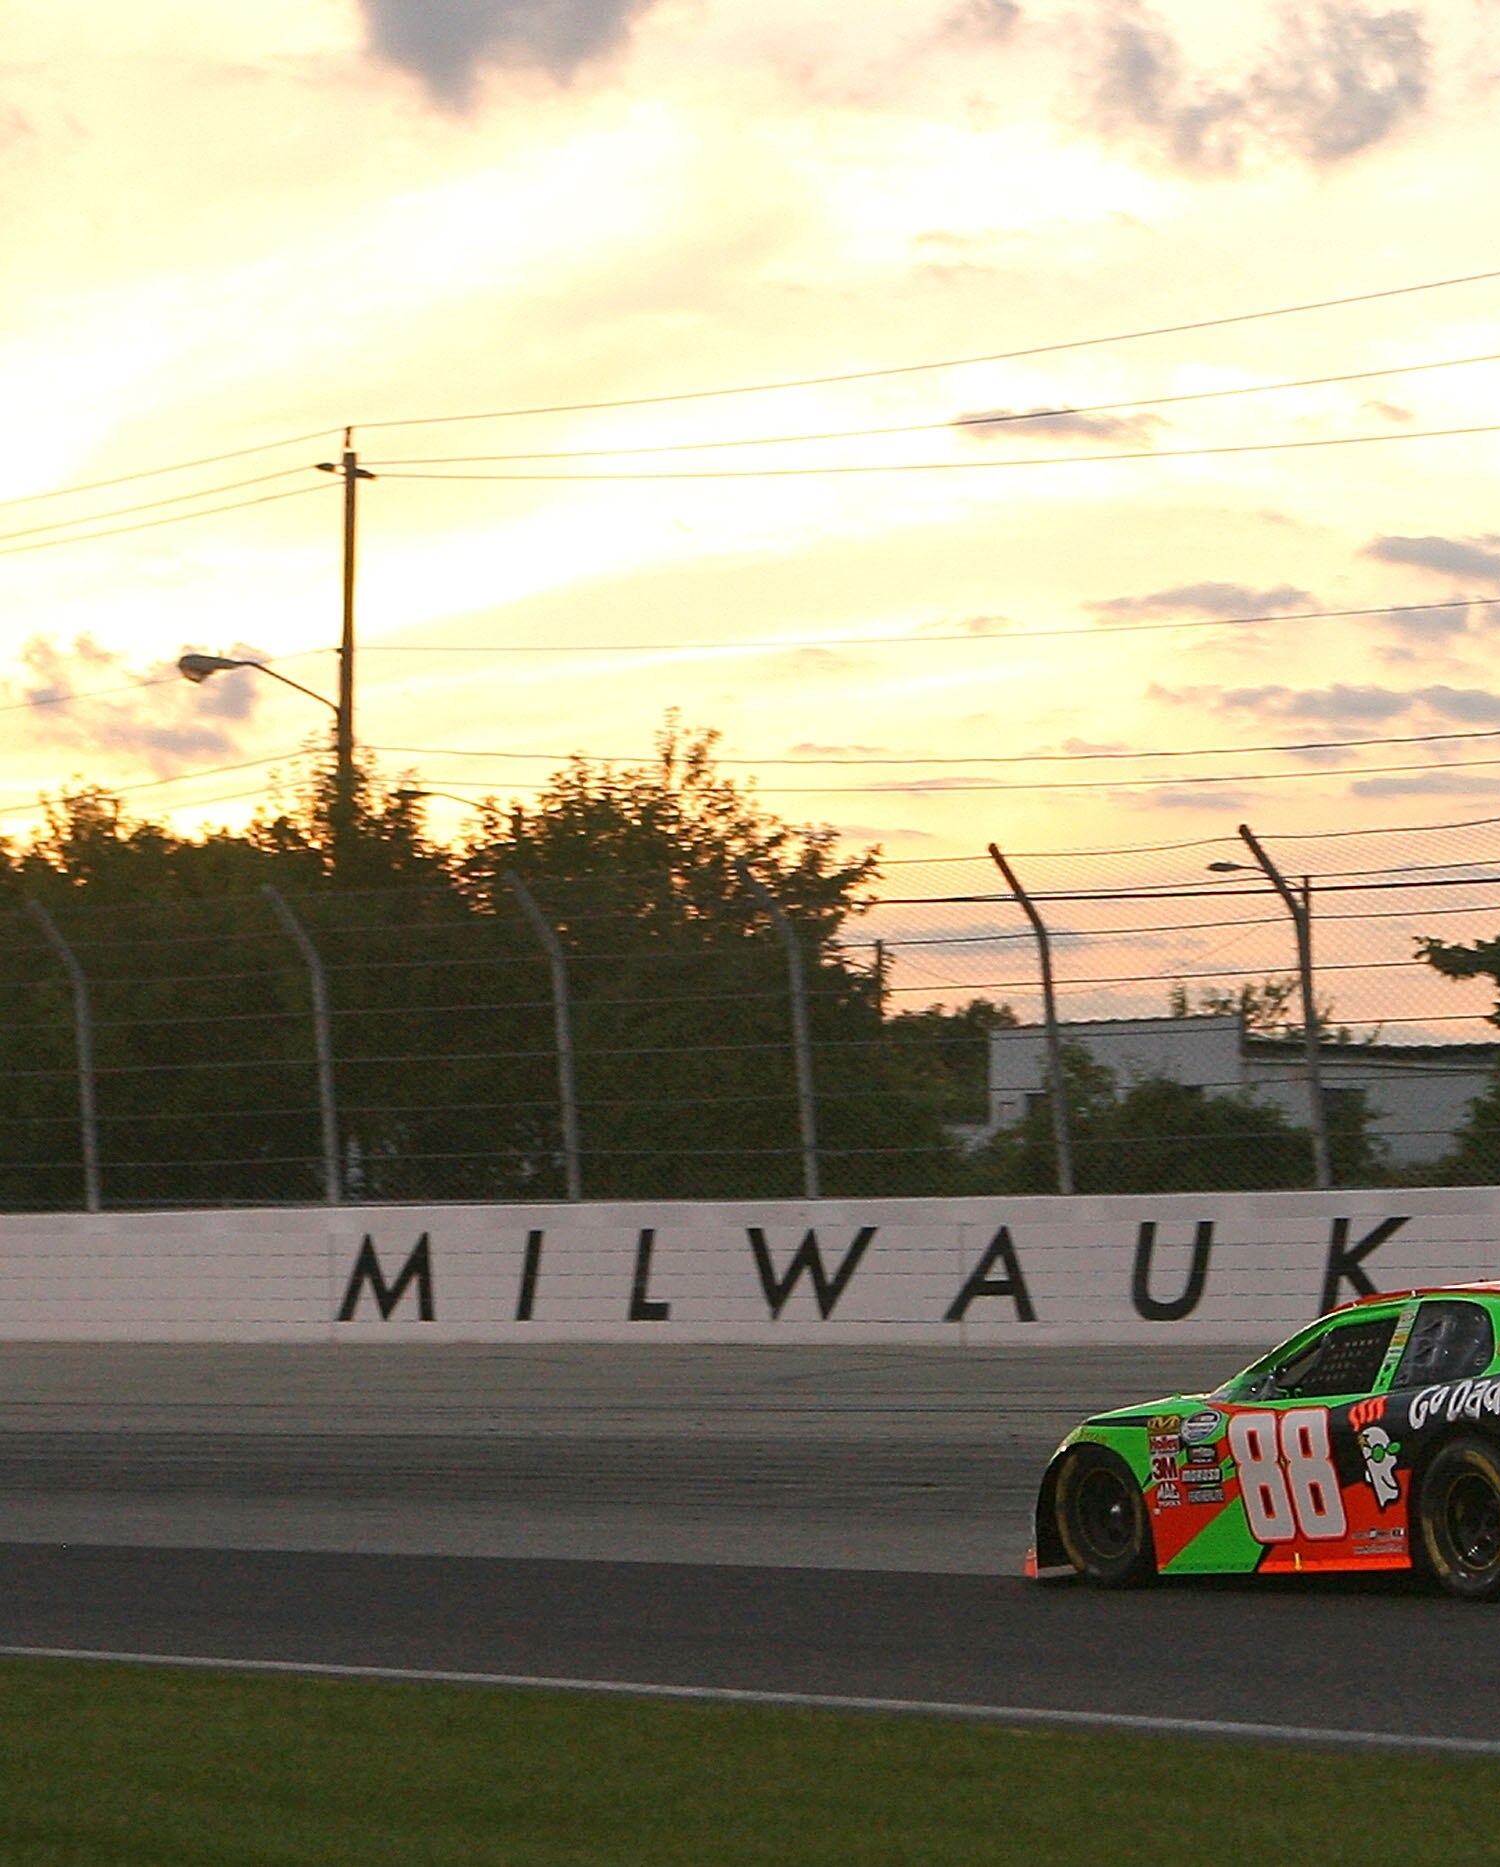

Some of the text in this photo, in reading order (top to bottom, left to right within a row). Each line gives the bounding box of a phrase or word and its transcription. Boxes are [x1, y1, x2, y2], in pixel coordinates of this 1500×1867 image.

[1409, 1384, 1450, 1430] Go
[1152, 1457, 1178, 1480] 3M
[1228, 1407, 1347, 1542] 88
